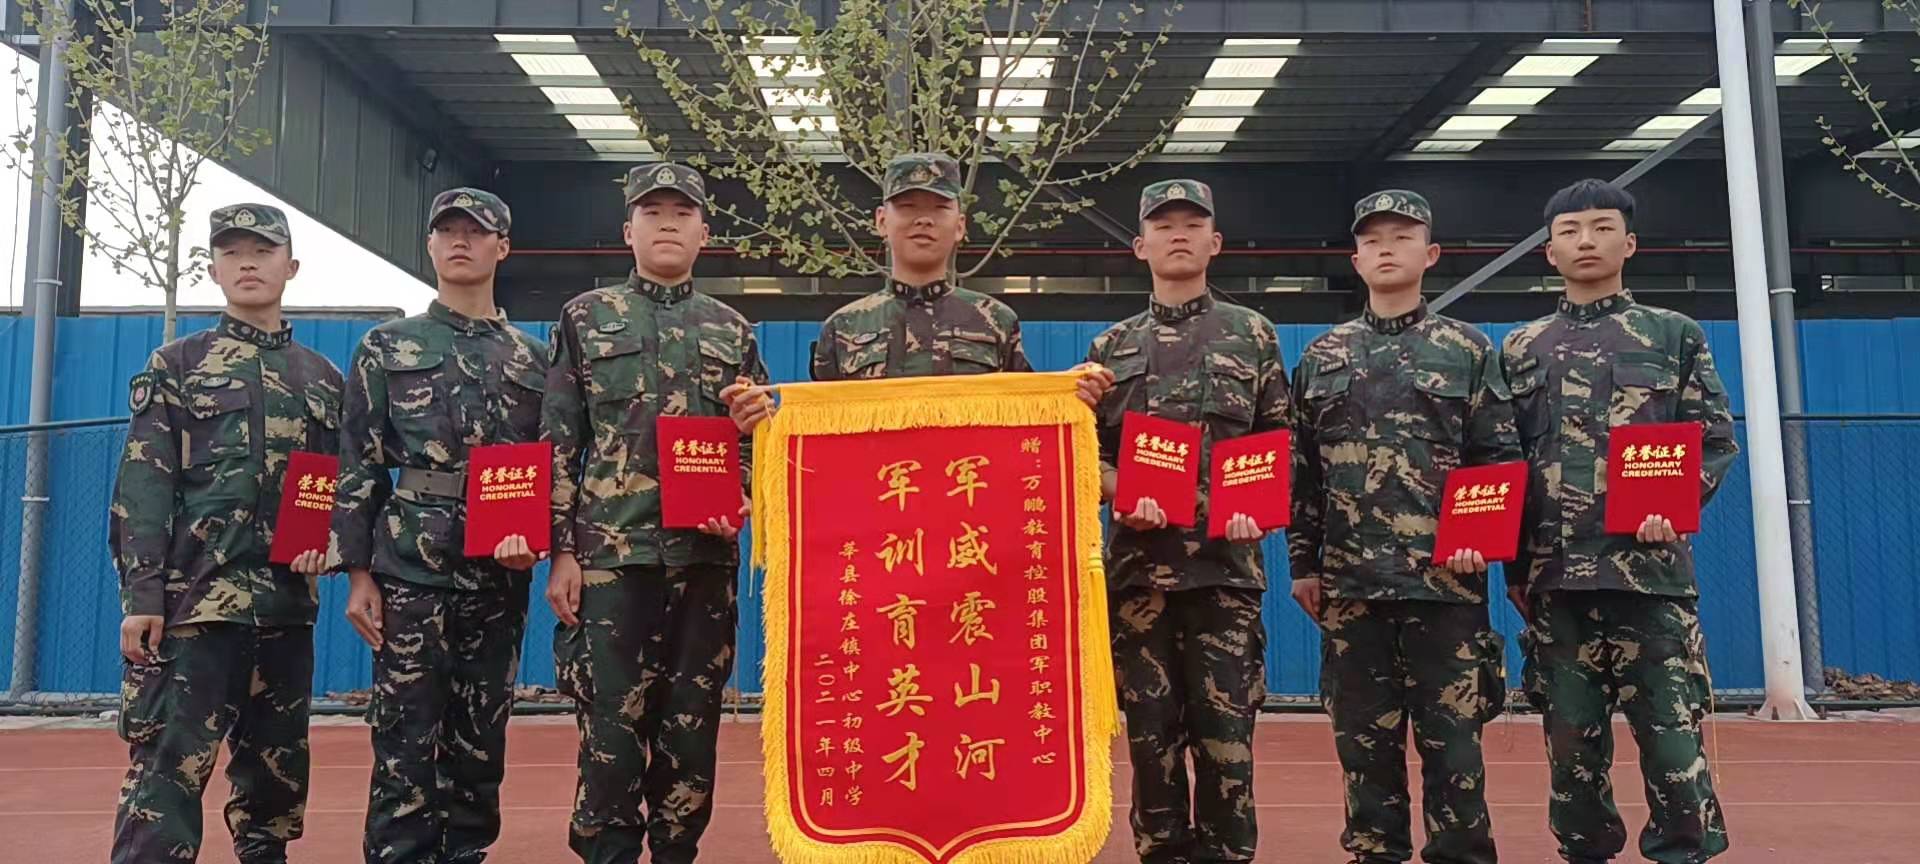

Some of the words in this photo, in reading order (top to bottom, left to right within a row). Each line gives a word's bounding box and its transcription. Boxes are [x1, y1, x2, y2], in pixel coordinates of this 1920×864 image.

[672, 438, 728, 456] 荣誉证书
[1134, 432, 1189, 457] 荣誉证书
[1136, 448, 1185, 464] HONORARY
[1621, 444, 1686, 461] 荣誉证书
[675, 457, 726, 465] HONORARY
[1133, 455, 1186, 473] CREDENTIAL
[1221, 450, 1276, 473] 荣誉证书
[1624, 460, 1682, 469] HONORARY
[480, 465, 538, 484] 荣誉证书
[673, 465, 729, 473] CREDENTIAL
[1224, 465, 1273, 479] HONORARY
[1621, 468, 1684, 478] CREDENTIAL
[297, 473, 336, 493] 荣誉
[481, 482, 534, 492] HONORARY
[1222, 472, 1276, 487] CREDENTIAL
[298, 492, 335, 503] HONOR
[479, 490, 536, 501] CREDENTIAL
[1453, 482, 1510, 501] 荣誉证书
[294, 499, 333, 511] CREDEN
[1451, 504, 1507, 515] CREDENTIAL
[1455, 497, 1505, 507] HONORARY
[875, 459, 933, 791] 军训育英才
[945, 455, 1005, 781] 军威震山河
